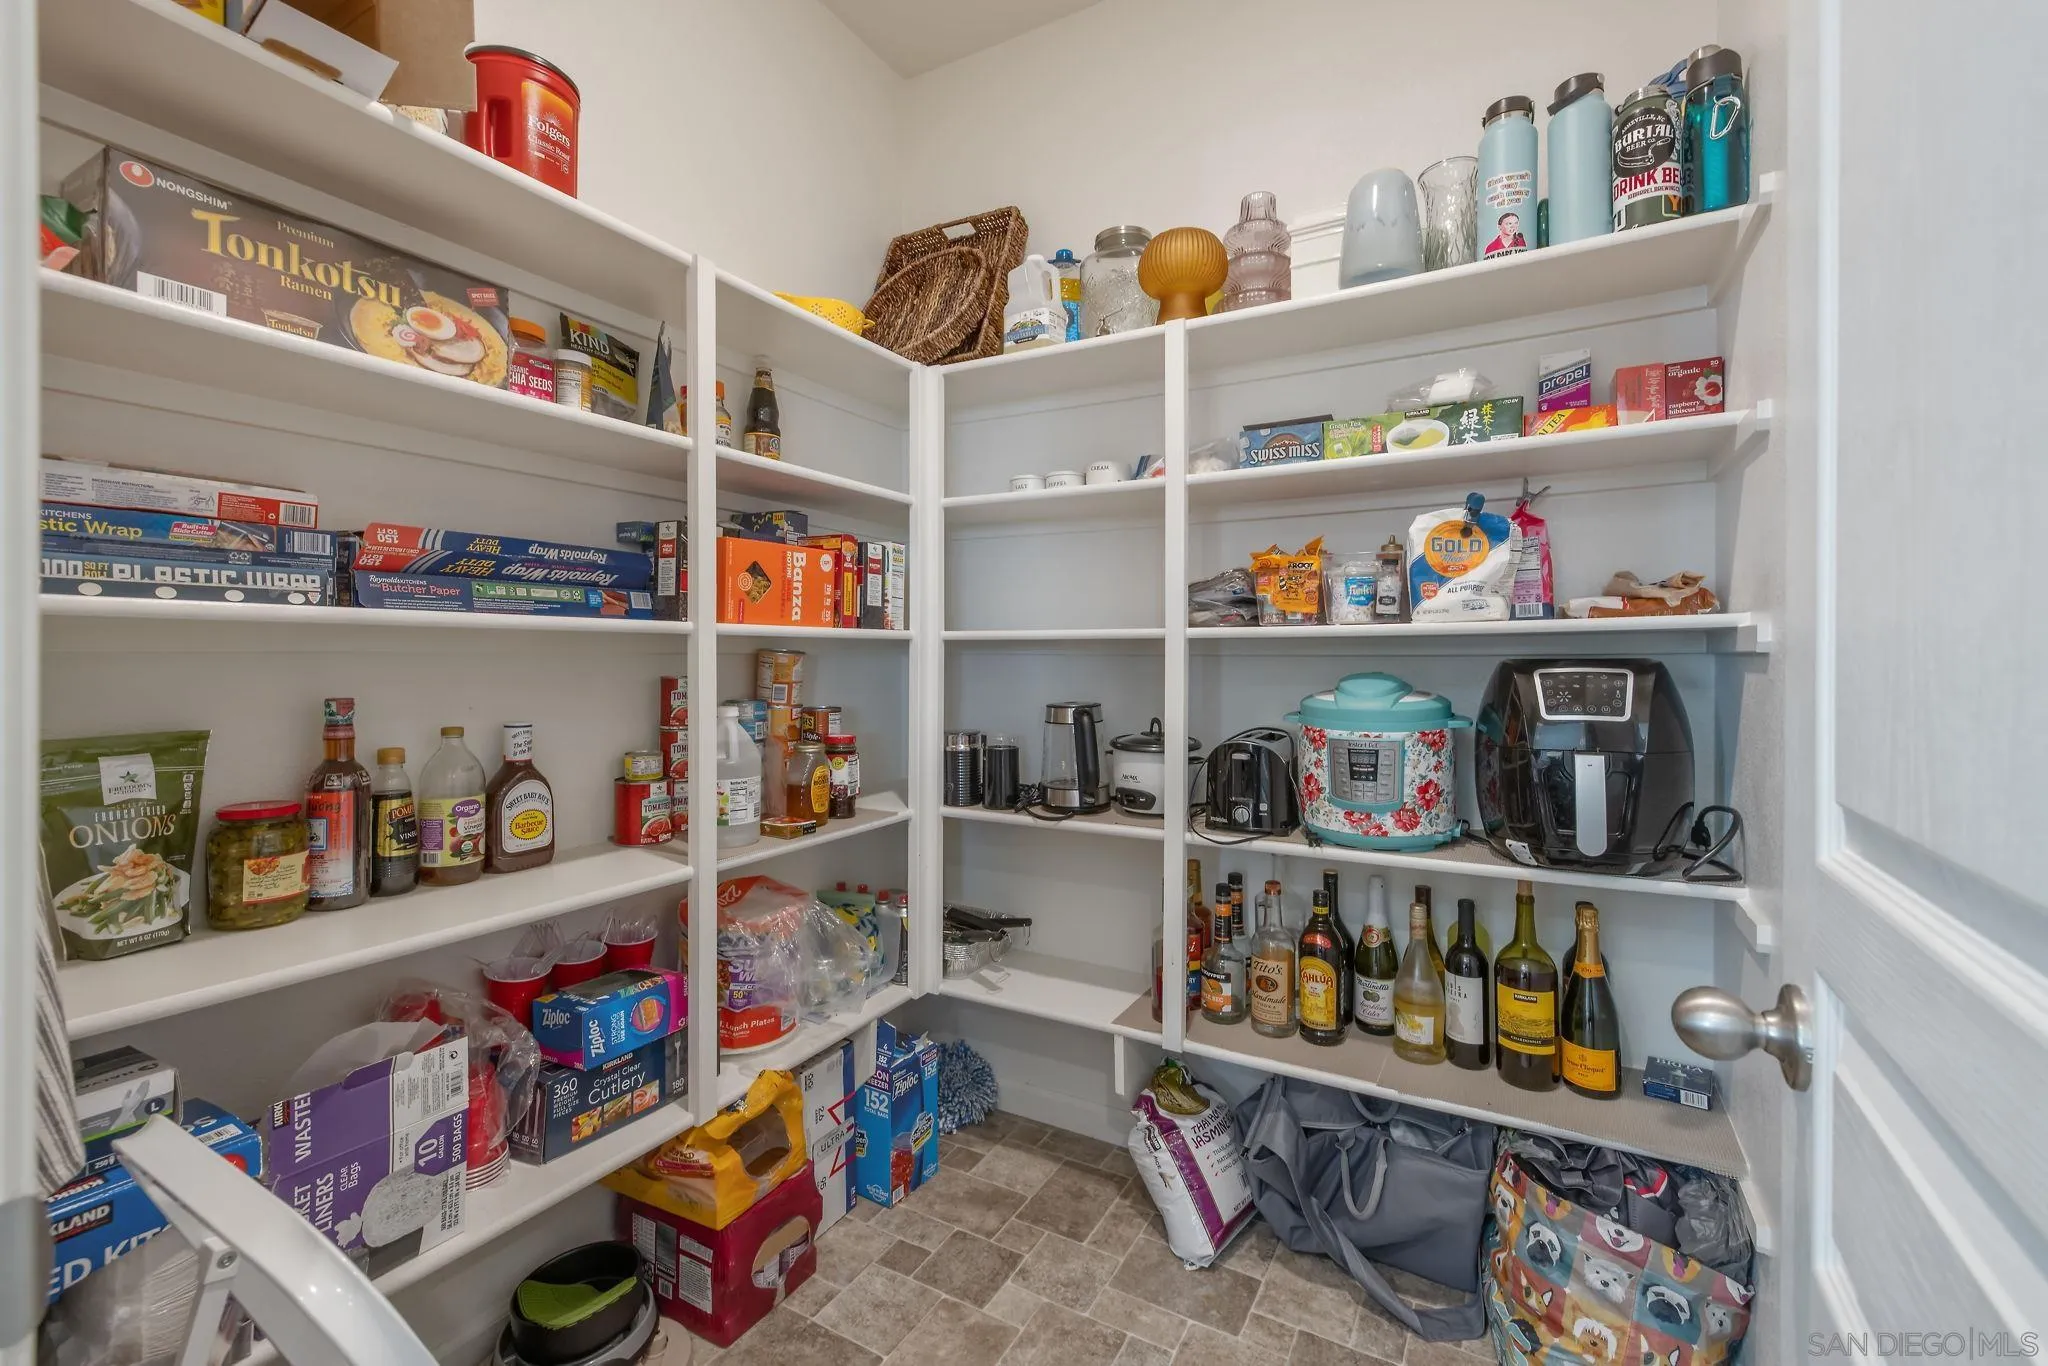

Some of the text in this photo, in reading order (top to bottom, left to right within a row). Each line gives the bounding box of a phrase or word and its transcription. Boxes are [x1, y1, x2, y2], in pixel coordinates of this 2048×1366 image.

[528, 114, 571, 148] Folgers
[1614, 123, 1673, 154] BURIAL
[1626, 139, 1647, 153] BEER
[156, 176, 228, 210] NONGSHIM
[1613, 166, 1680, 202] DRINK BE
[277, 220, 335, 249] Premium
[190, 207, 401, 307] Tonkotsu
[280, 274, 333, 301] Ramen
[268, 317, 316, 340] Tonkotsu
[569, 328, 610, 355] KIND
[1542, 367, 1589, 393] propel
[1667, 367, 1701, 378] organic
[529, 375, 553, 392] SEEDS
[1405, 409, 1430, 417] KIRKLAND
[1668, 400, 1701, 411] raspberry
[1668, 406, 1696, 415] hibiscus
[1547, 411, 1566, 430] TEA
[1250, 442, 1321, 465] SWISS MISS
[40, 518, 143, 540] stic Wrap
[377, 533, 399, 544] 150
[467, 543, 502, 554] HEAVY
[474, 537, 499, 546] DUTY
[1431, 537, 1483, 553] GOLD
[359, 558, 383, 566] 150
[455, 558, 497, 568] DUTY
[528, 543, 608, 565] Reynolds Wrap
[369, 574, 401, 584] Reynolds
[441, 564, 497, 577] HEAVY
[501, 562, 620, 586] Reynolds Wrap
[382, 582, 462, 597] Butcher Paper
[792, 551, 807, 622] Banza
[1447, 585, 1459, 594] ALL
[455, 803, 480, 812] Organic
[505, 791, 550, 812] SWEET BABY RAY'S
[69, 812, 177, 848] ONIONS
[515, 819, 544, 831] Barbecue
[520, 826, 540, 836] Sauce
[1299, 966, 1334, 989] KAHLÚA
[1252, 989, 1288, 1004] Handmade
[542, 1008, 571, 1029] Ziploc
[1362, 1008, 1381, 1018] Cider
[726, 1016, 775, 1032] Lunch Plates
[588, 1019, 606, 1058] Ziploc
[602, 1052, 634, 1071] KIRKLAND
[593, 1062, 642, 1088] Crystal Clear
[672, 1077, 686, 1090] 180
[894, 1072, 919, 1098] Ziploc
[553, 1077, 578, 1099] 360
[553, 1090, 578, 1104] PREMIUM
[588, 1072, 646, 1105] Cutlery
[553, 1097, 576, 1109] WEIGHT
[864, 1088, 889, 1114] 152
[553, 1108, 573, 1119] PIECES
[294, 1091, 312, 1164] WASTE
[453, 1113, 463, 1142] BAGS
[1191, 1118, 1211, 1134] THAI
[820, 1130, 845, 1152] ULTRA
[418, 1138, 438, 1168] 10
[452, 1143, 462, 1163] 500
[340, 1166, 348, 1192] CLEAR
[348, 1161, 361, 1189] Bags
[315, 1172, 334, 1233] LINERS
